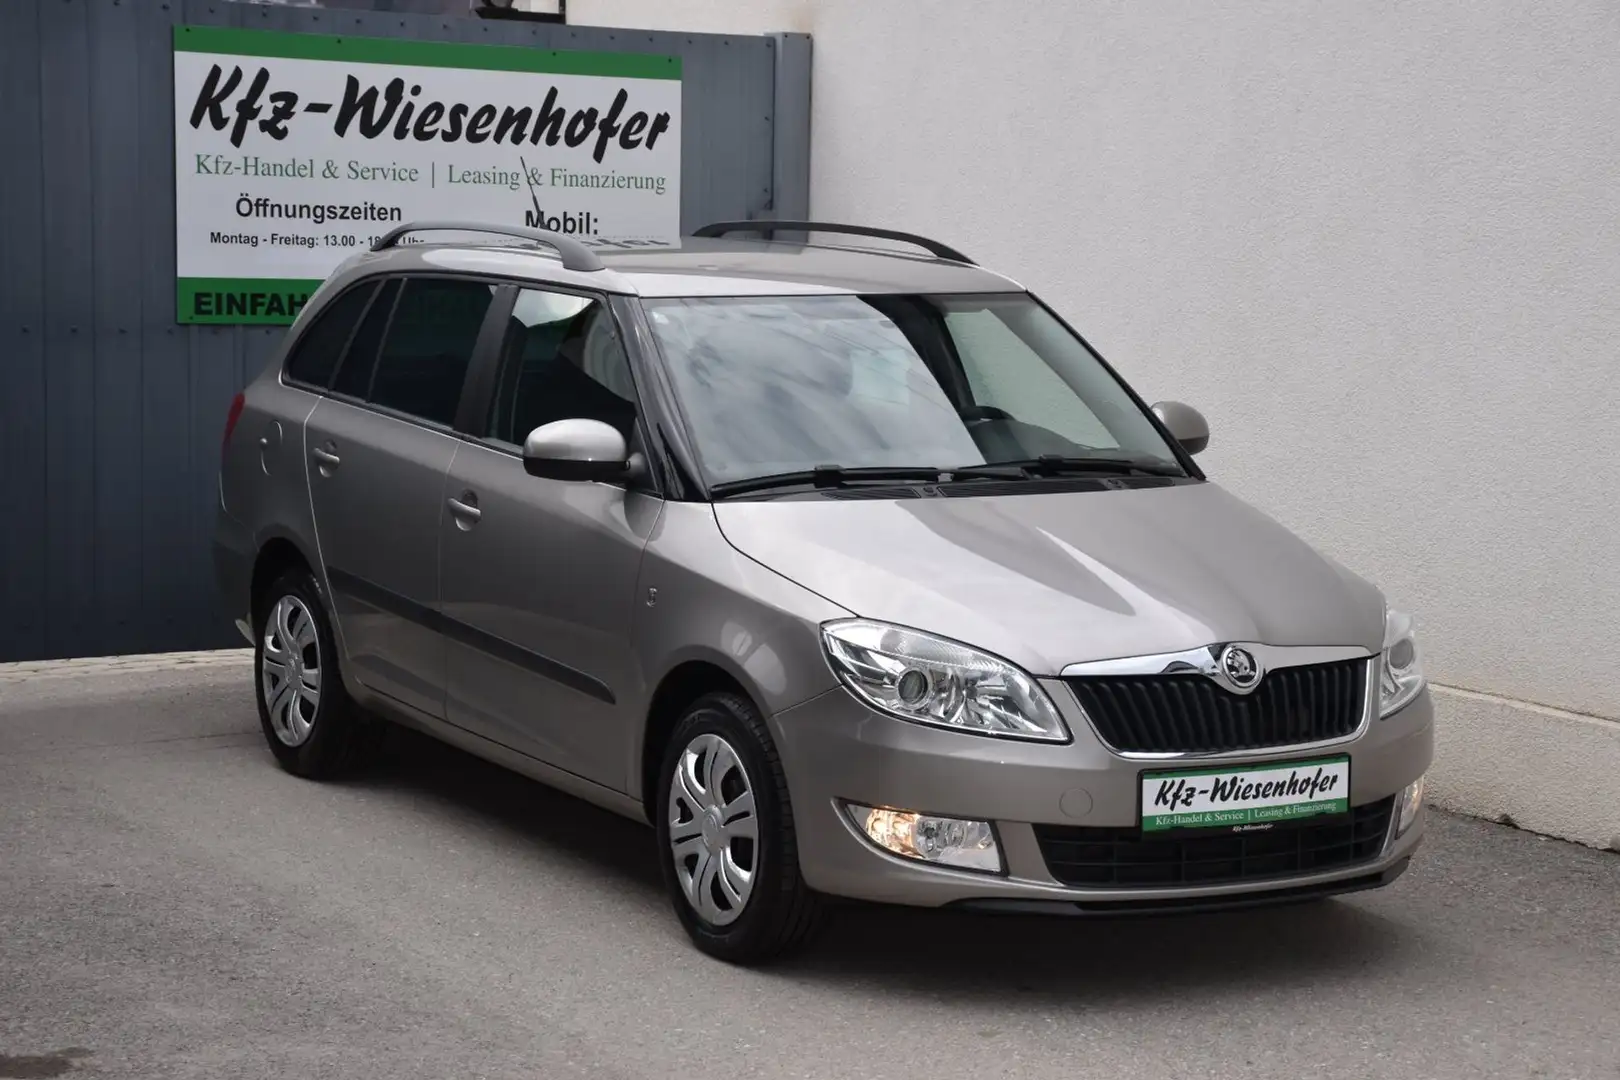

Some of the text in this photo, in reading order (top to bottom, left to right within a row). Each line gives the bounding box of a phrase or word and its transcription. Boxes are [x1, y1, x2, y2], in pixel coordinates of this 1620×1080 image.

[189, 63, 671, 164] Kfz-Wiesenhofer
[195, 153, 315, 179] Kfz-Handel
[321, 159, 340, 180] &
[347, 160, 419, 182] Service
[448, 164, 521, 191] Leasing
[527, 167, 543, 187] &
[550, 168, 667, 195] Finanzierung
[235, 192, 402, 224] Öffnungszeiten
[525, 209, 599, 236] Mobil:
[209, 231, 259, 248] Montag
[271, 232, 319, 248] Freitag:
[323, 235, 356, 247] 13.00
[1154, 766, 1339, 811] Kfz-Wiesenhofer
[1155, 810, 1203, 826] Kfz-Handel
[1204, 812, 1213, 823] &
[1214, 810, 1245, 822] Service
[1254, 807, 1284, 820] Leasing
